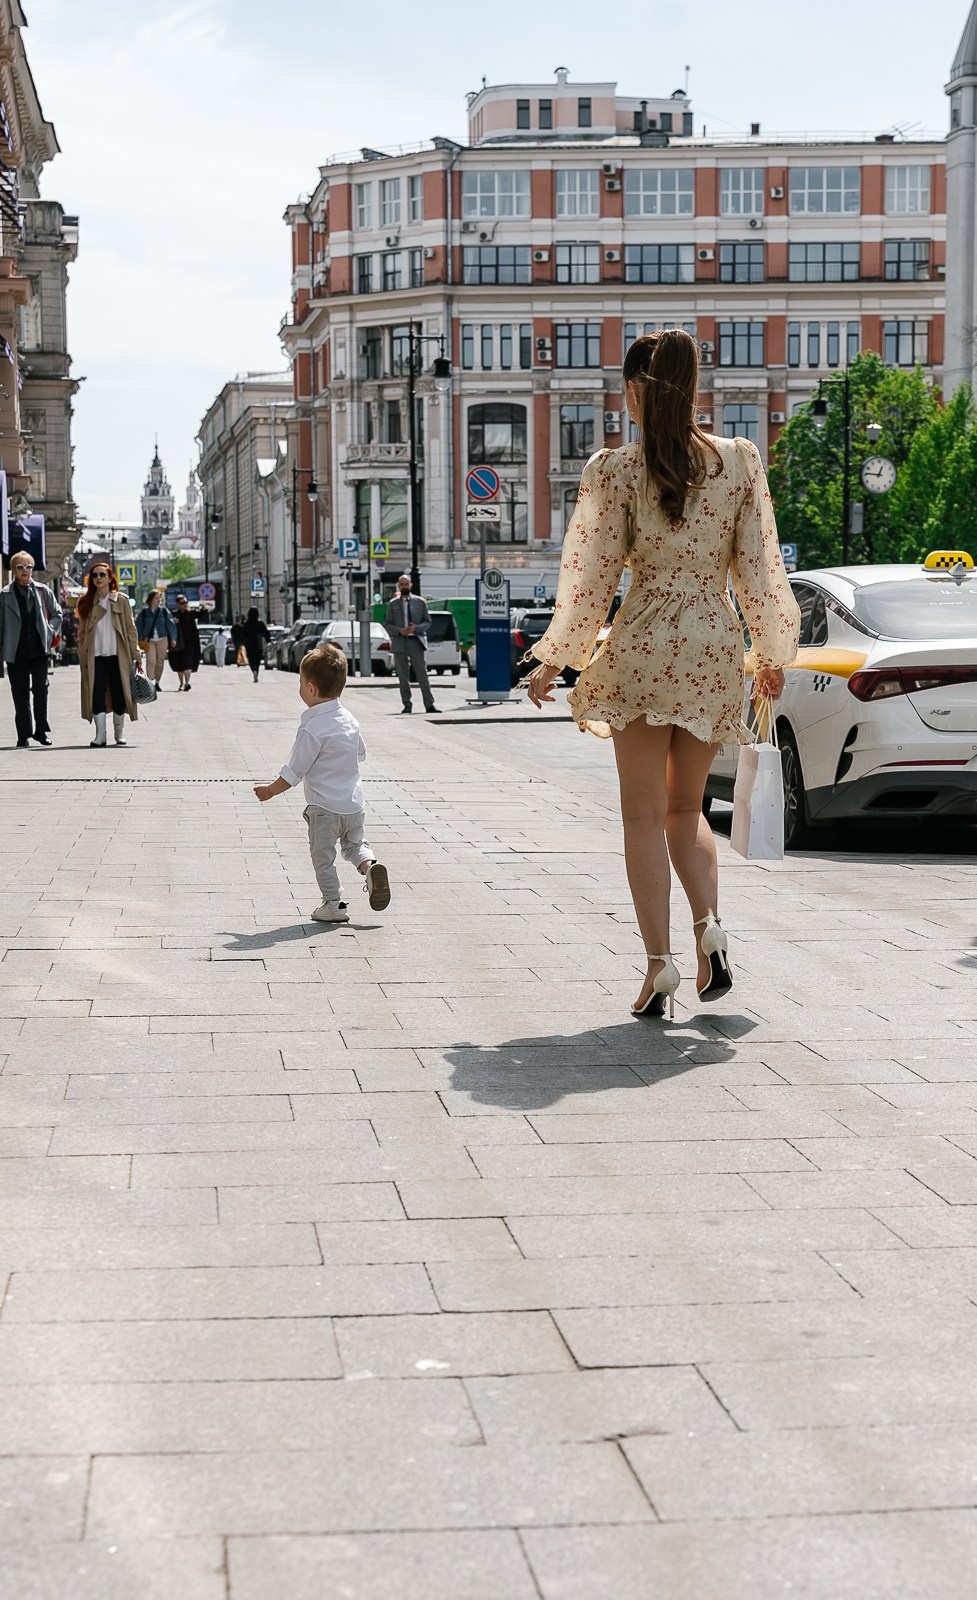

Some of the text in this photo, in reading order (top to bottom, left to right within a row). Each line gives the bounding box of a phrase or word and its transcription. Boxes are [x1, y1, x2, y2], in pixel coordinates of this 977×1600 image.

[343, 540, 356, 557] P
[254, 579, 262, 590] P
[536, 586, 544, 596] P
